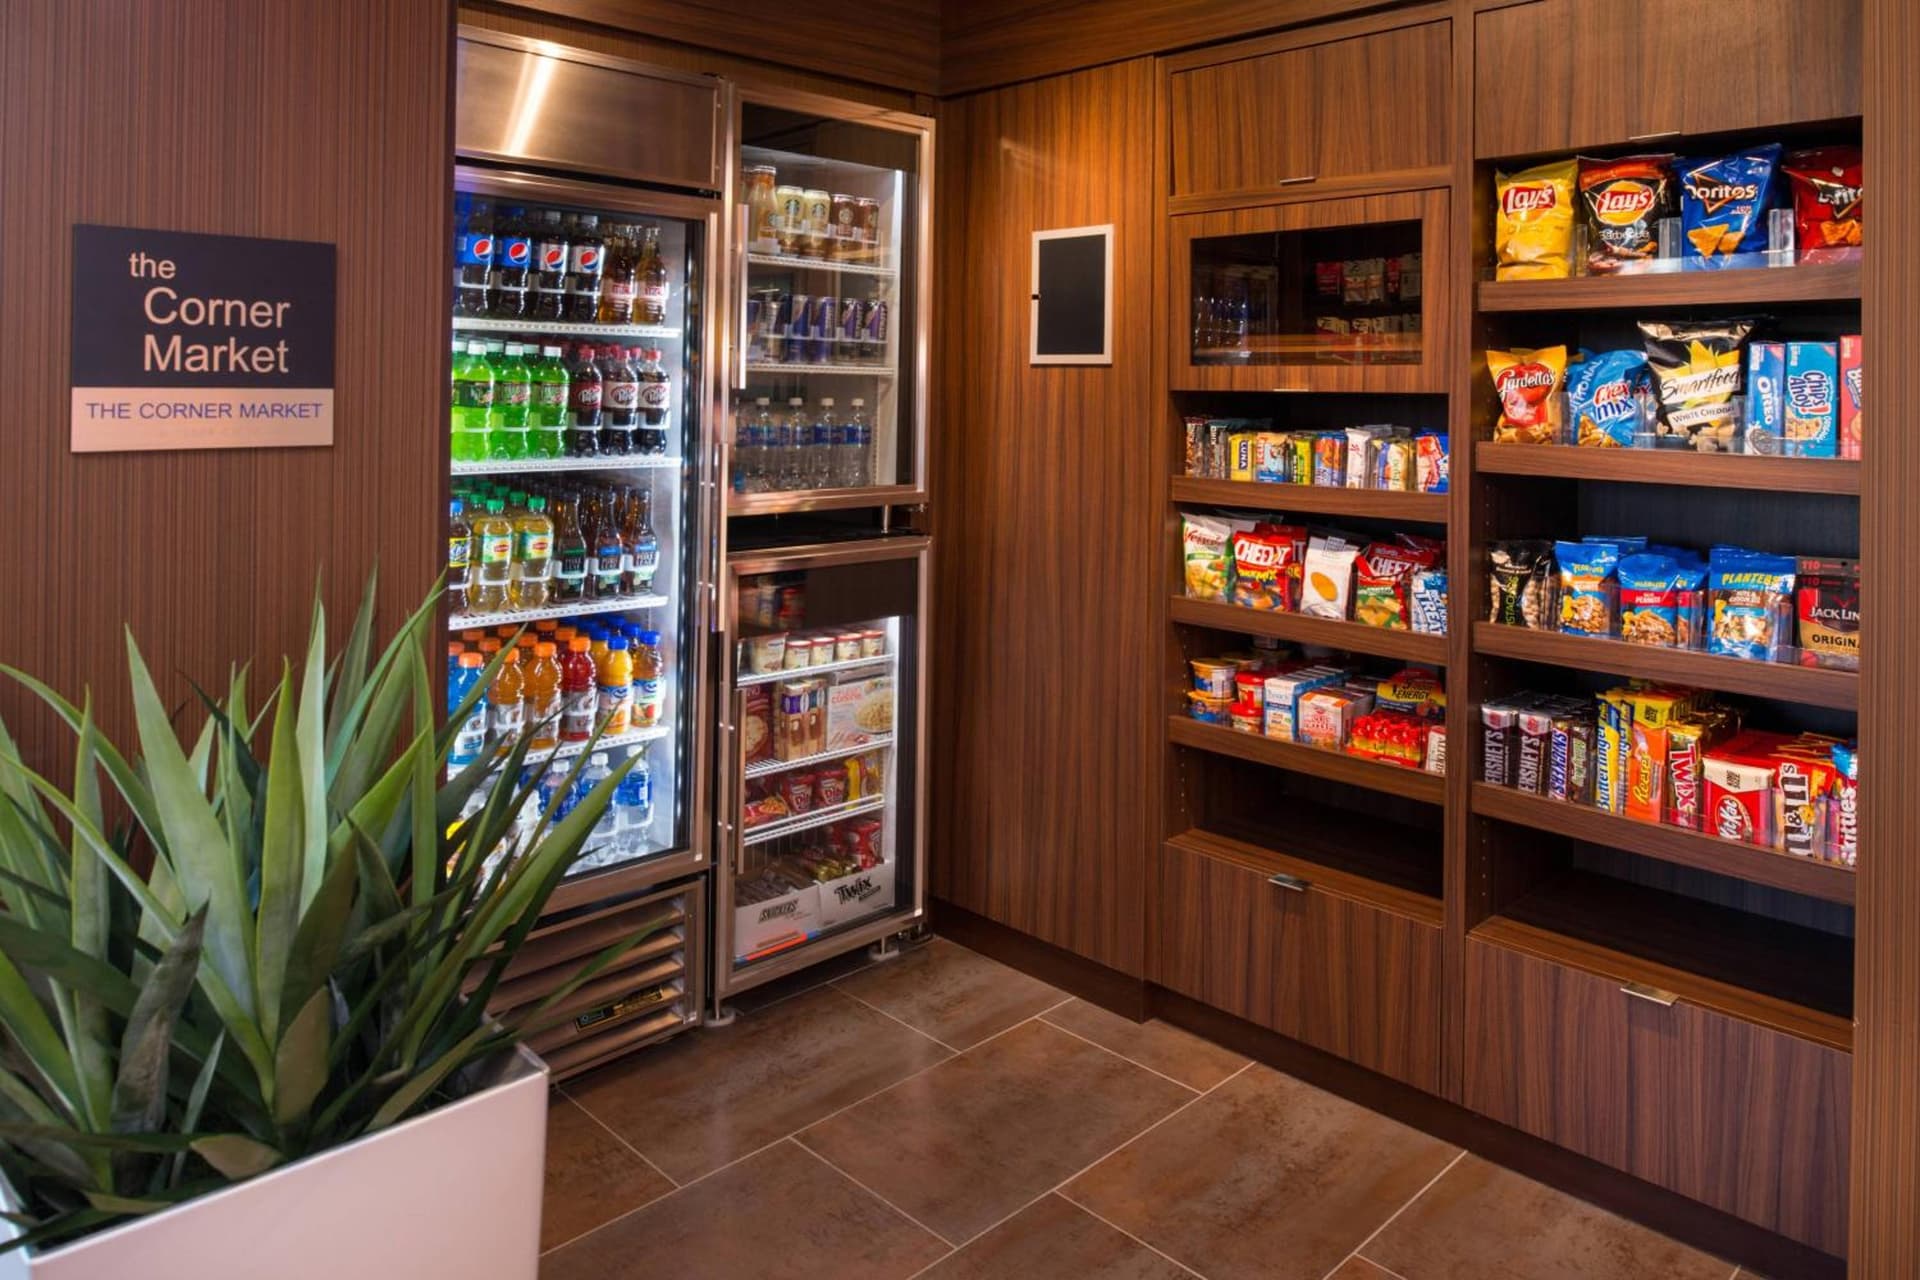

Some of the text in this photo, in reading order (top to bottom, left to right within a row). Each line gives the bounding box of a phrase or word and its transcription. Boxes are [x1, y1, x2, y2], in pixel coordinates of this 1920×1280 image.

[1506, 184, 1553, 214] Lay's
[1599, 187, 1650, 214] Lay's
[1684, 183, 1757, 200] Doritos
[128, 251, 176, 280] the
[143, 286, 291, 329] Corner
[143, 333, 289, 374] Market
[1660, 367, 1741, 401] Smartfood
[1757, 375, 1775, 425] OREO
[1803, 371, 1827, 407] Chips
[86, 402, 324, 420] THE CORNER MARKET
[1415, 590, 1442, 634] TREA
[1809, 605, 1840, 620] JACK
[1484, 729, 1504, 785] ERSHEY'S
[1519, 735, 1540, 792] ERSHEY'S
[1550, 728, 1568, 797] SNICKERS
[1669, 742, 1697, 811] TWIX
